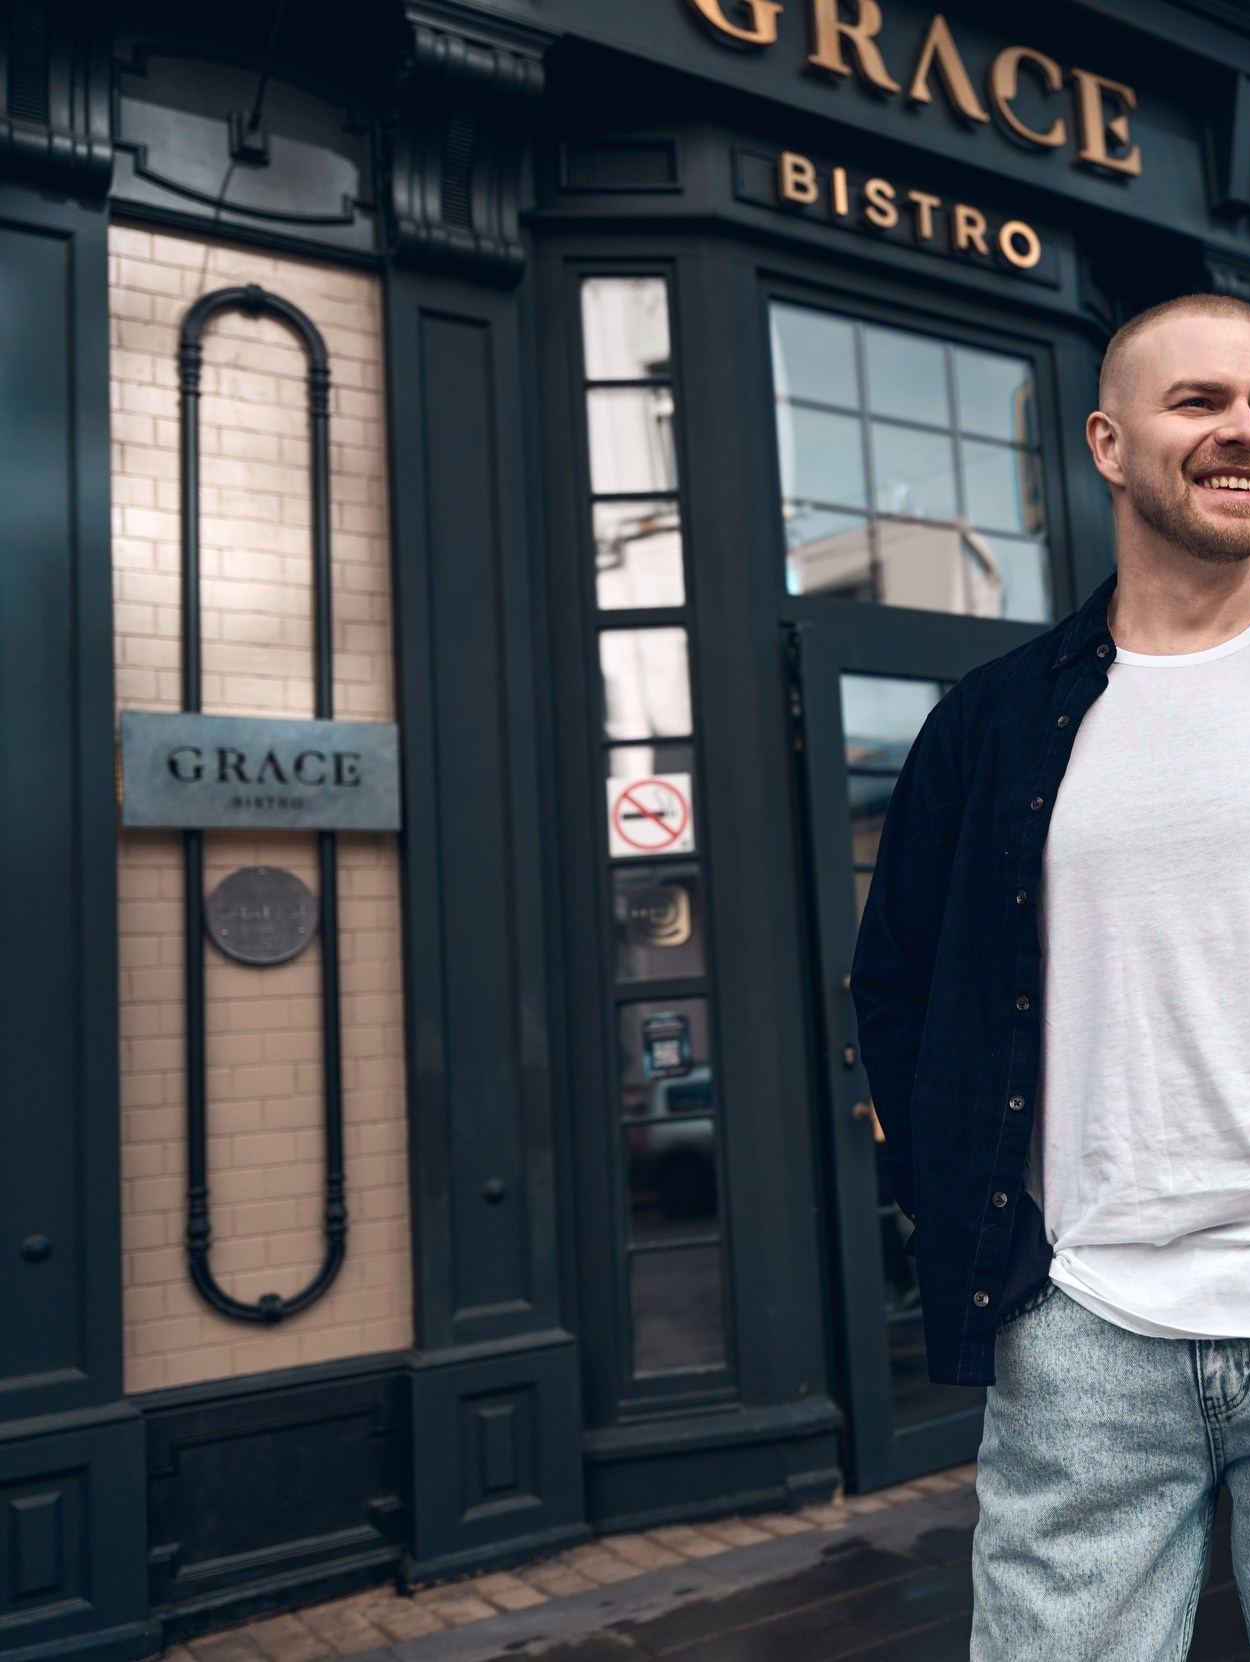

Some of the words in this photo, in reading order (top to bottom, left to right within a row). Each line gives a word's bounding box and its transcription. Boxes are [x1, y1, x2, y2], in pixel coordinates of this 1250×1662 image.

[779, 151, 1042, 269] BISTRO
[167, 745, 361, 787] GRACE
[231, 795, 304, 810] BISTRO
